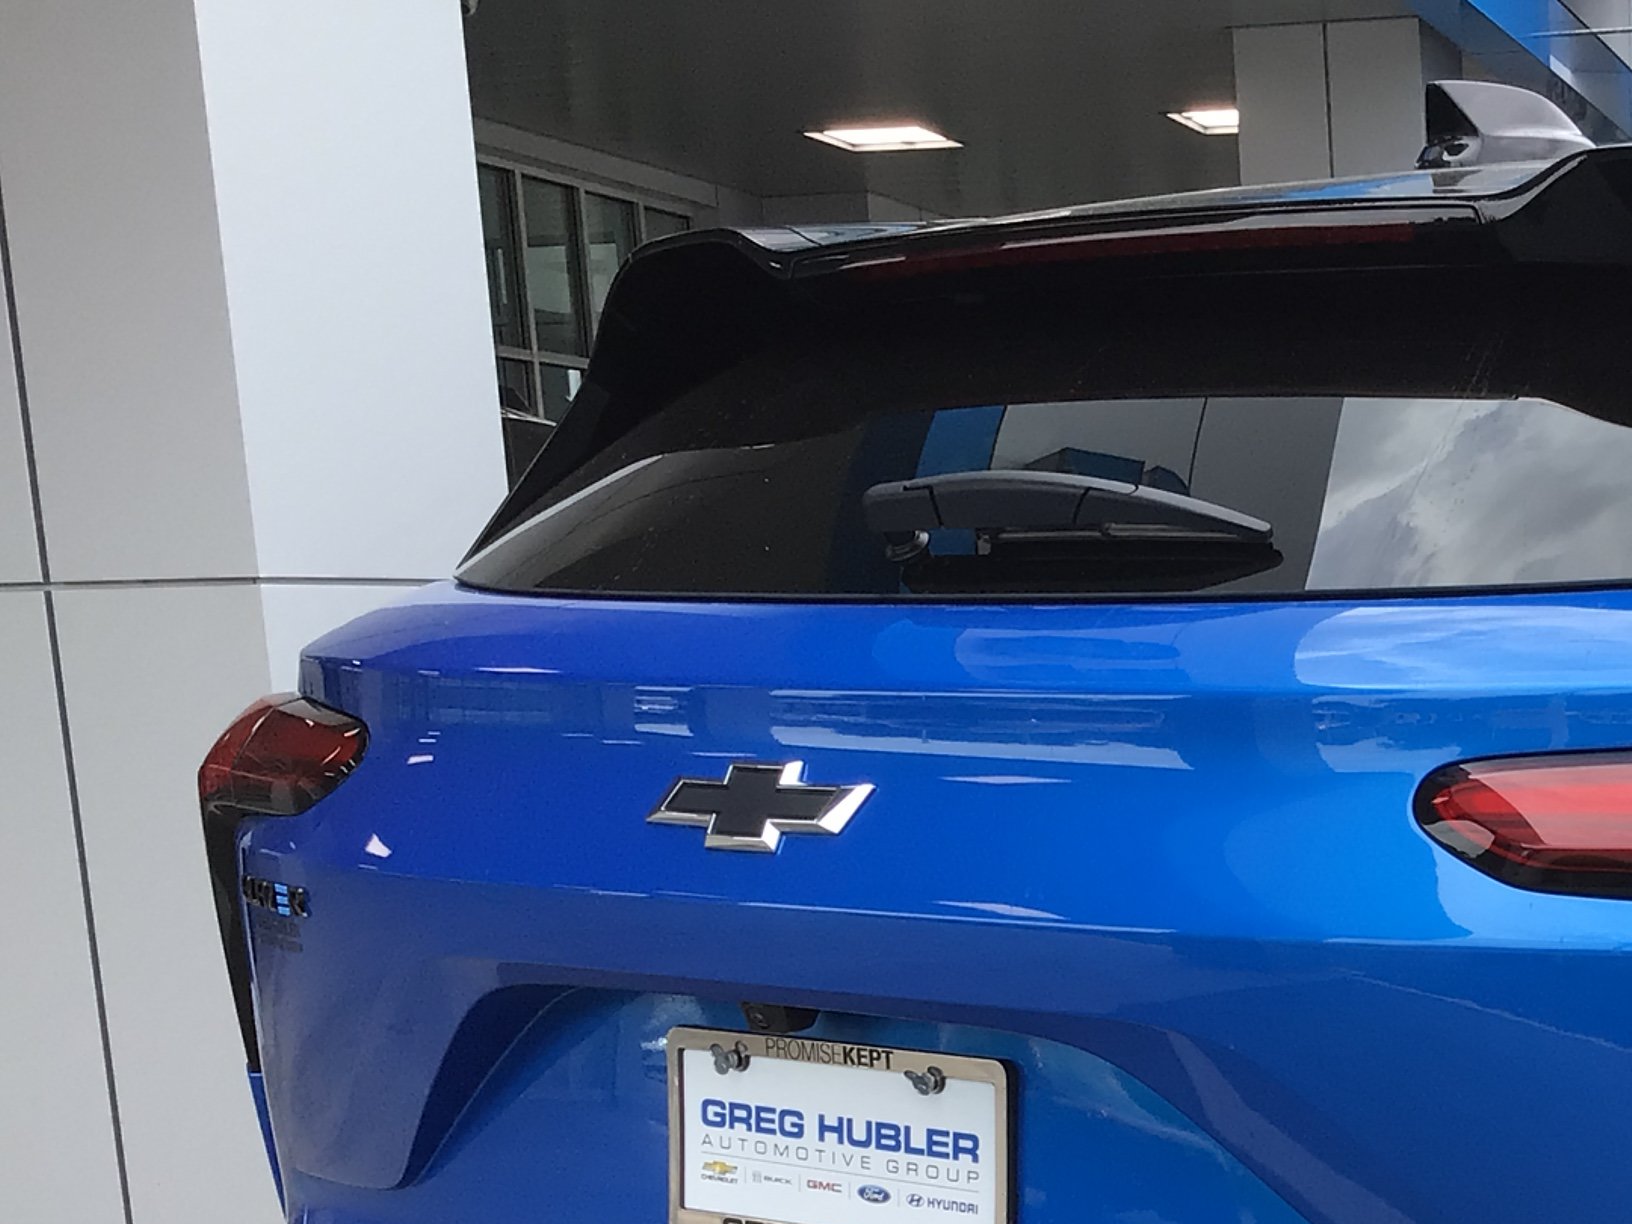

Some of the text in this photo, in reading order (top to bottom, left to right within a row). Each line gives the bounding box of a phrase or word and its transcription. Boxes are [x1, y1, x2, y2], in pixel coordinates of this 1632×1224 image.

[765, 1037, 894, 1070] PROMISEKEPT
[701, 1098, 980, 1163] GREG HUBLER
[701, 1133, 980, 1184] AUTOMOTIVE GROUP
[763, 1175, 792, 1185] BUICK
[806, 1179, 843, 1193] GMC
[927, 1197, 979, 1215] HYUNDAI
